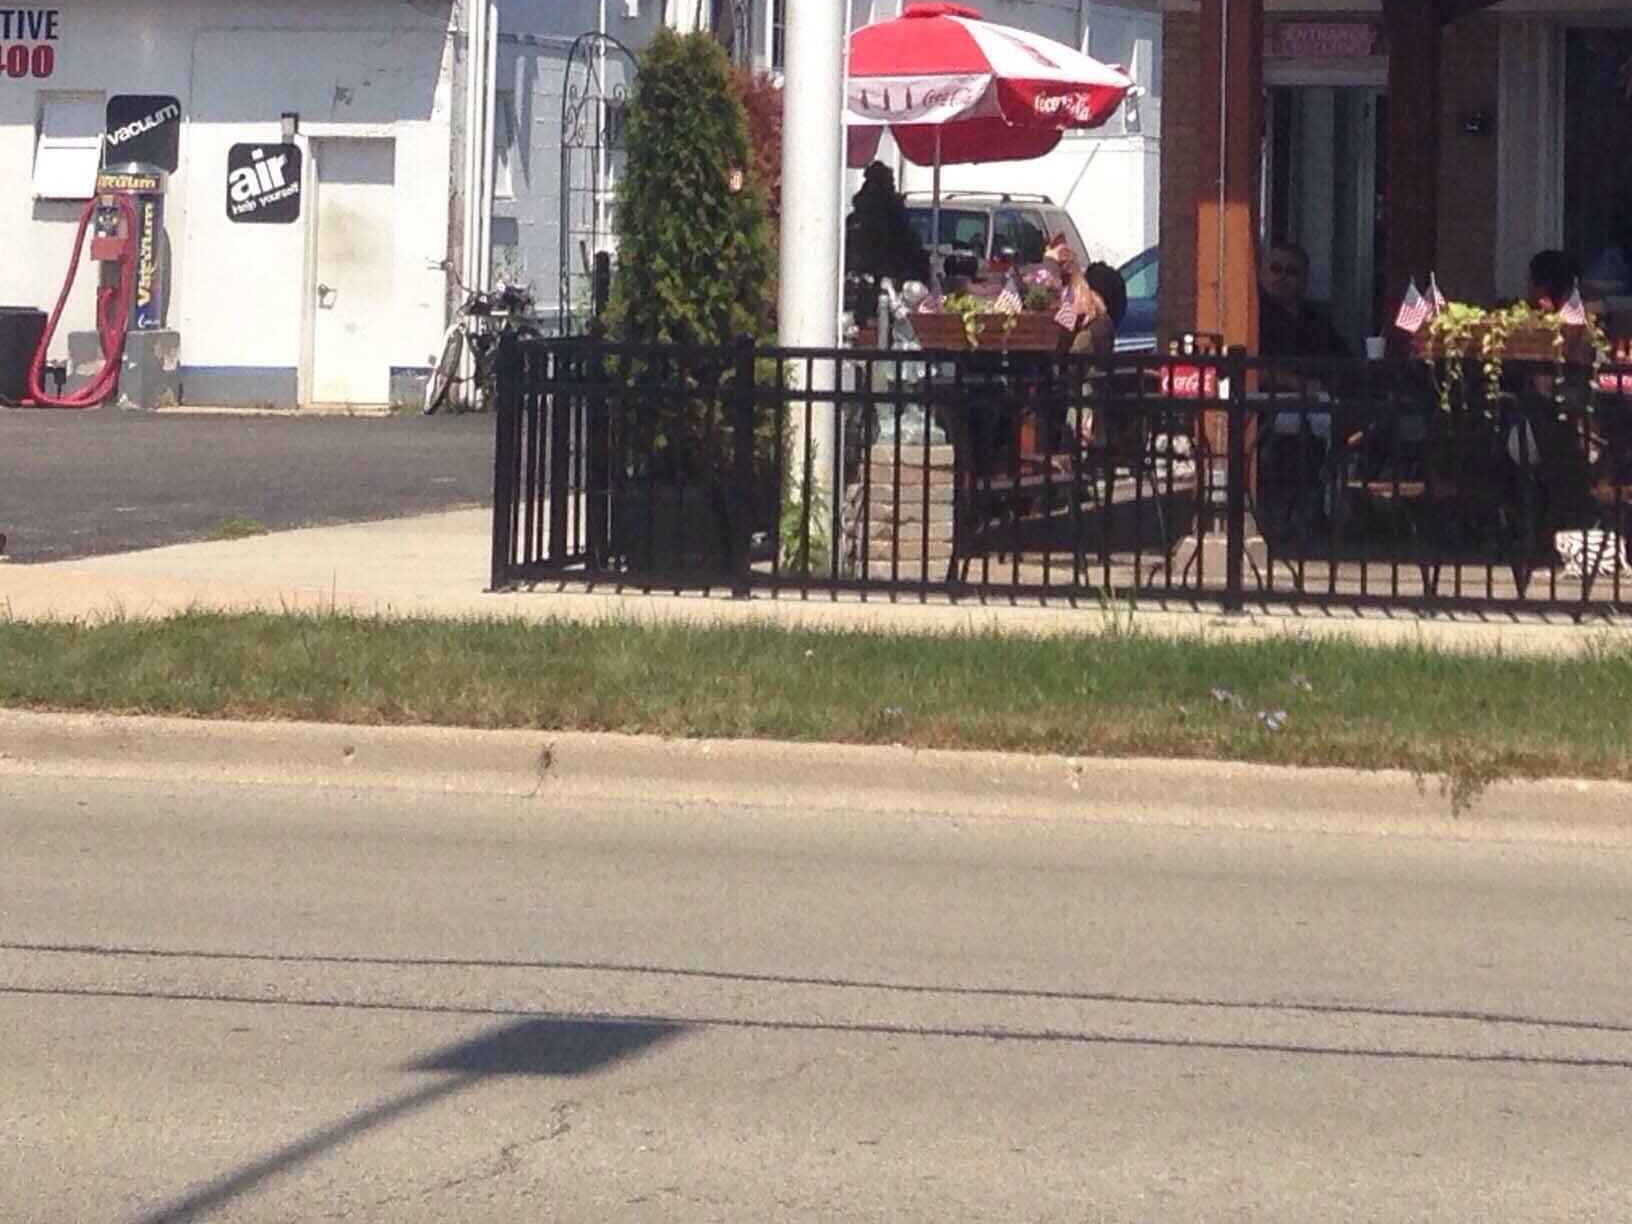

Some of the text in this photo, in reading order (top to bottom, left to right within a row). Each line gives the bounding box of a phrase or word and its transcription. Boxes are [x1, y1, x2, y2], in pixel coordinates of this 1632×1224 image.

[0, 9, 60, 41] TIVE
[0, 44, 55, 79] 00
[106, 103, 179, 146] vacuum
[228, 148, 288, 203] air
[258, 181, 299, 207] yourself
